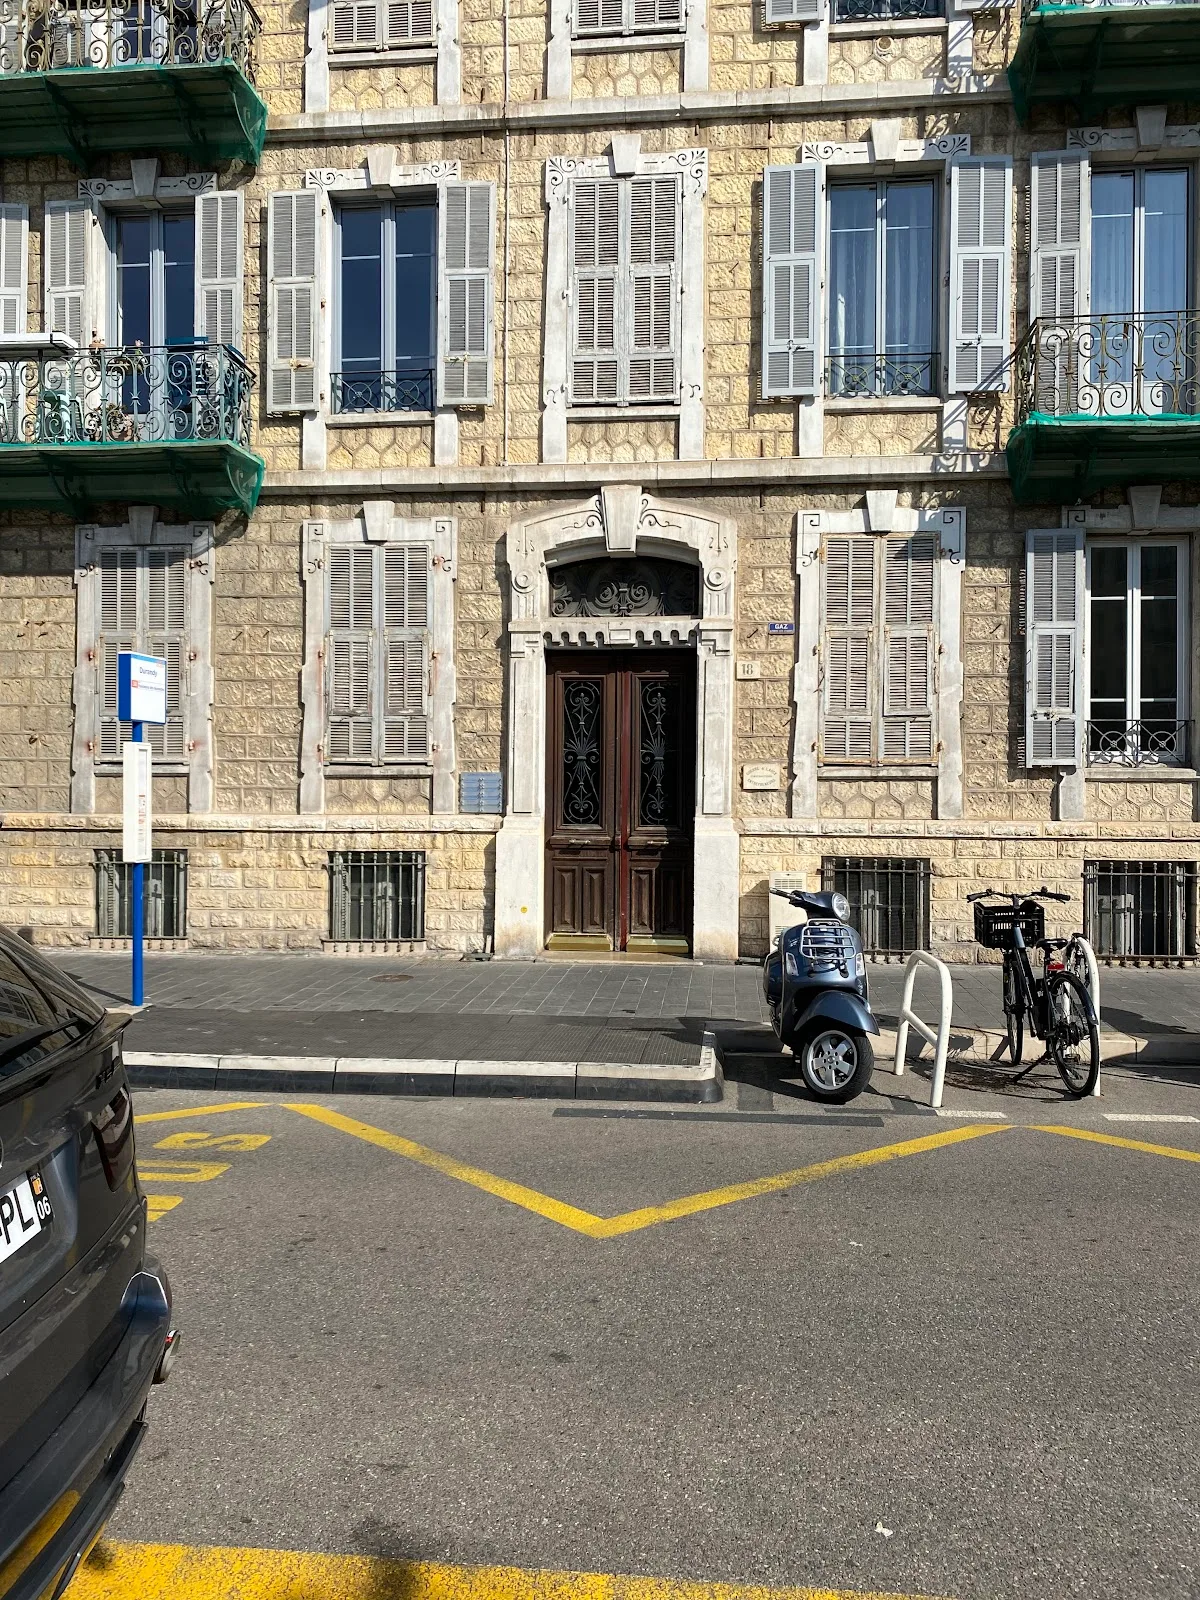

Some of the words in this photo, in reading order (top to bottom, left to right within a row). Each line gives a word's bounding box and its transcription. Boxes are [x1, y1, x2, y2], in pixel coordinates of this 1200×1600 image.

[140, 666, 158, 678] Durandy
[741, 663, 753, 675] 18
[36, 1195, 51, 1220] 06
